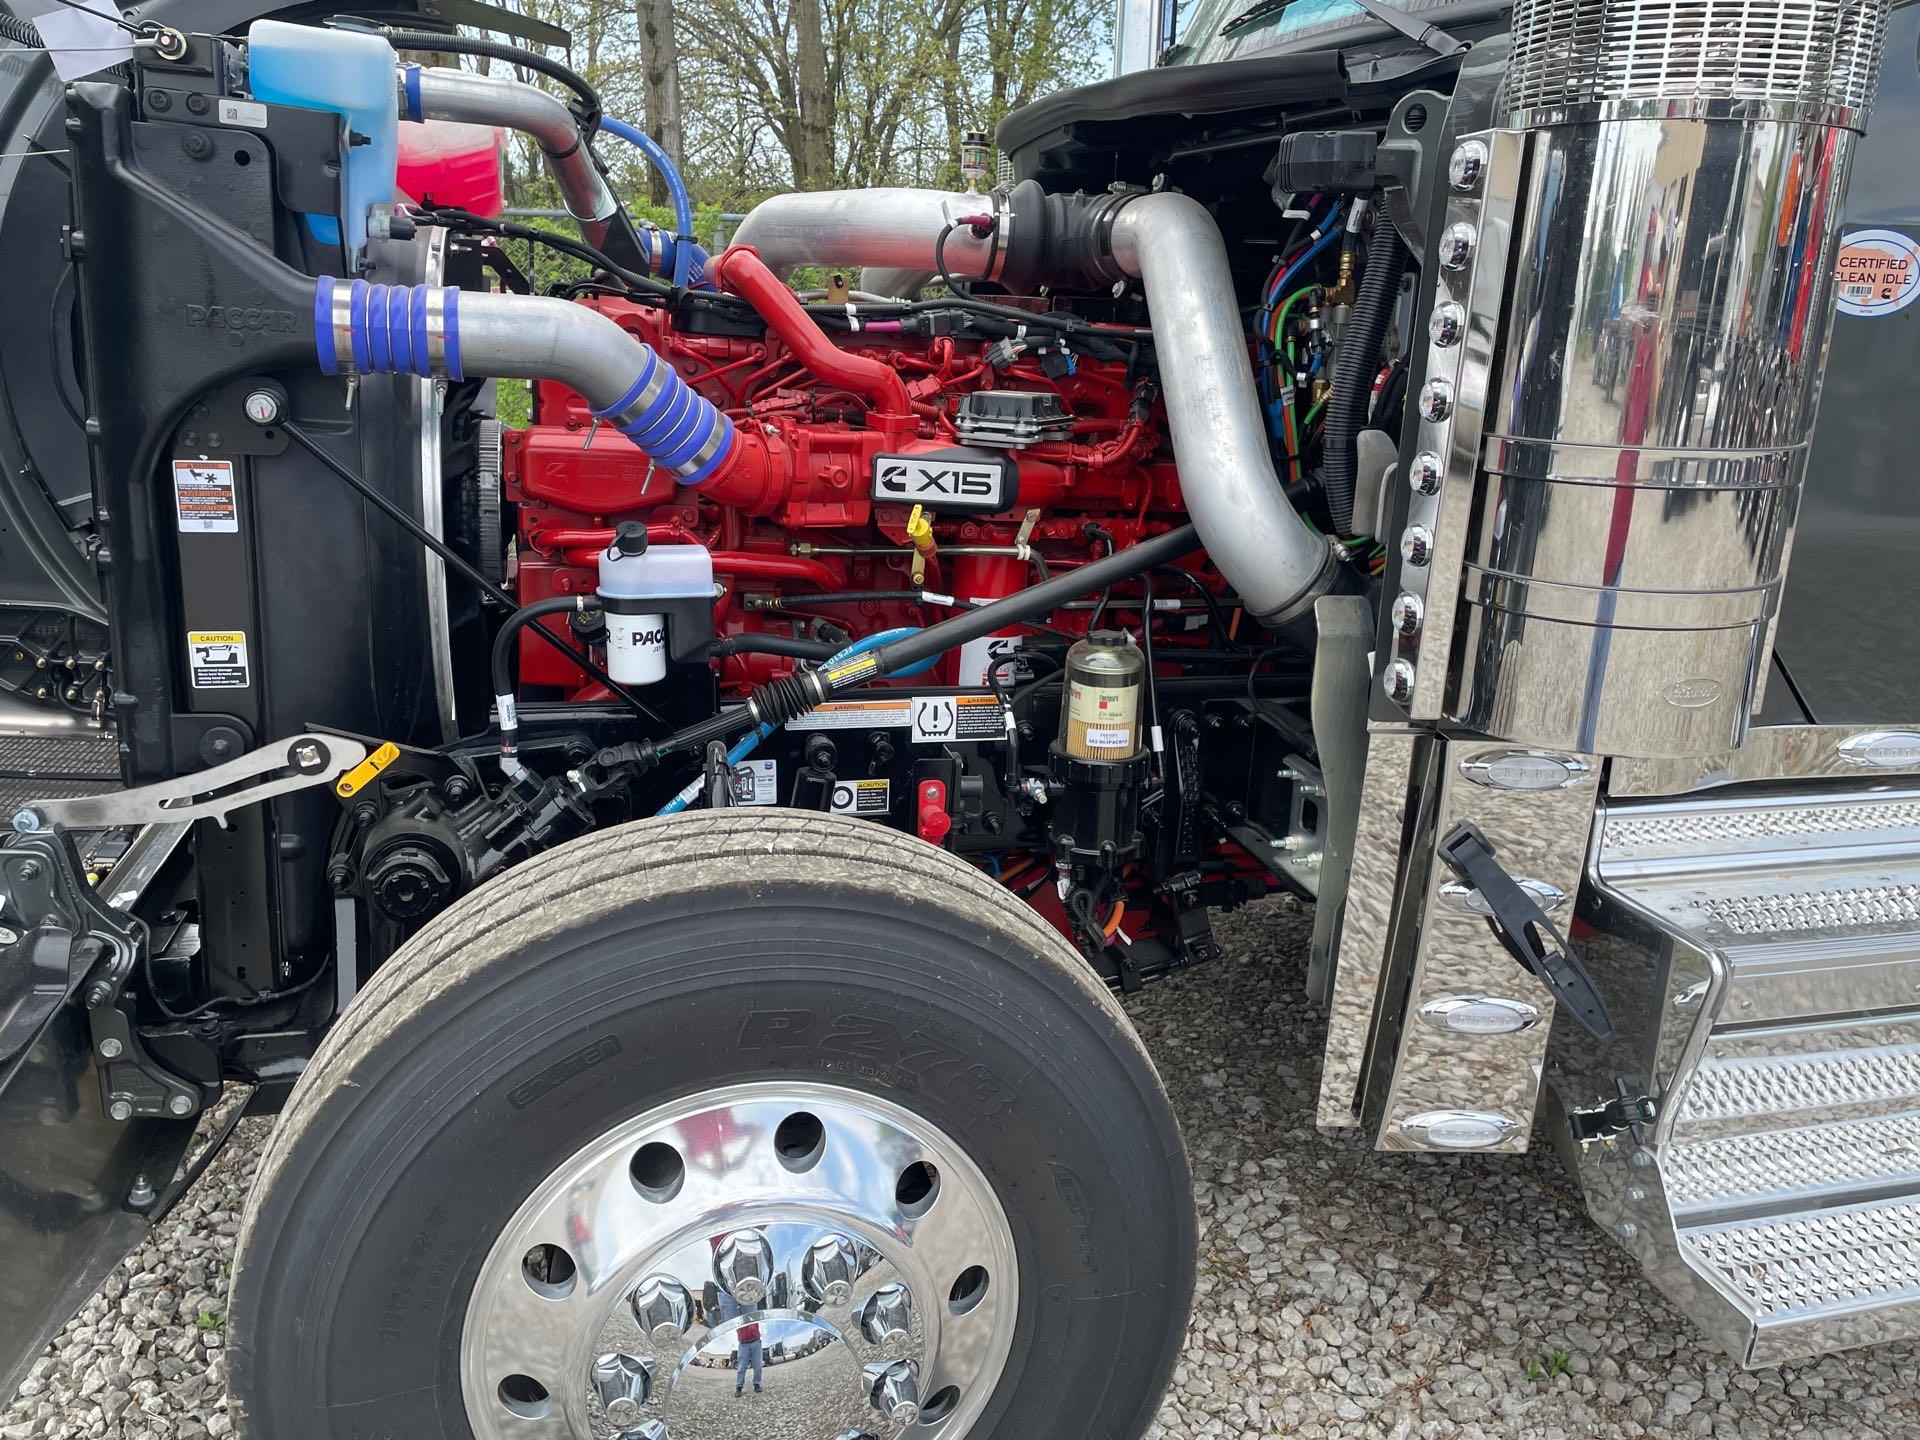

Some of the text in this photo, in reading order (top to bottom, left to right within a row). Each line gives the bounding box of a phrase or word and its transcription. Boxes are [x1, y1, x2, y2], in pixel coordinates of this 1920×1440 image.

[1839, 256, 1909, 271] CERTIFIED
[1882, 273, 1913, 285] IDLE
[184, 303, 298, 334] PACCAR
[914, 468, 993, 496] X15
